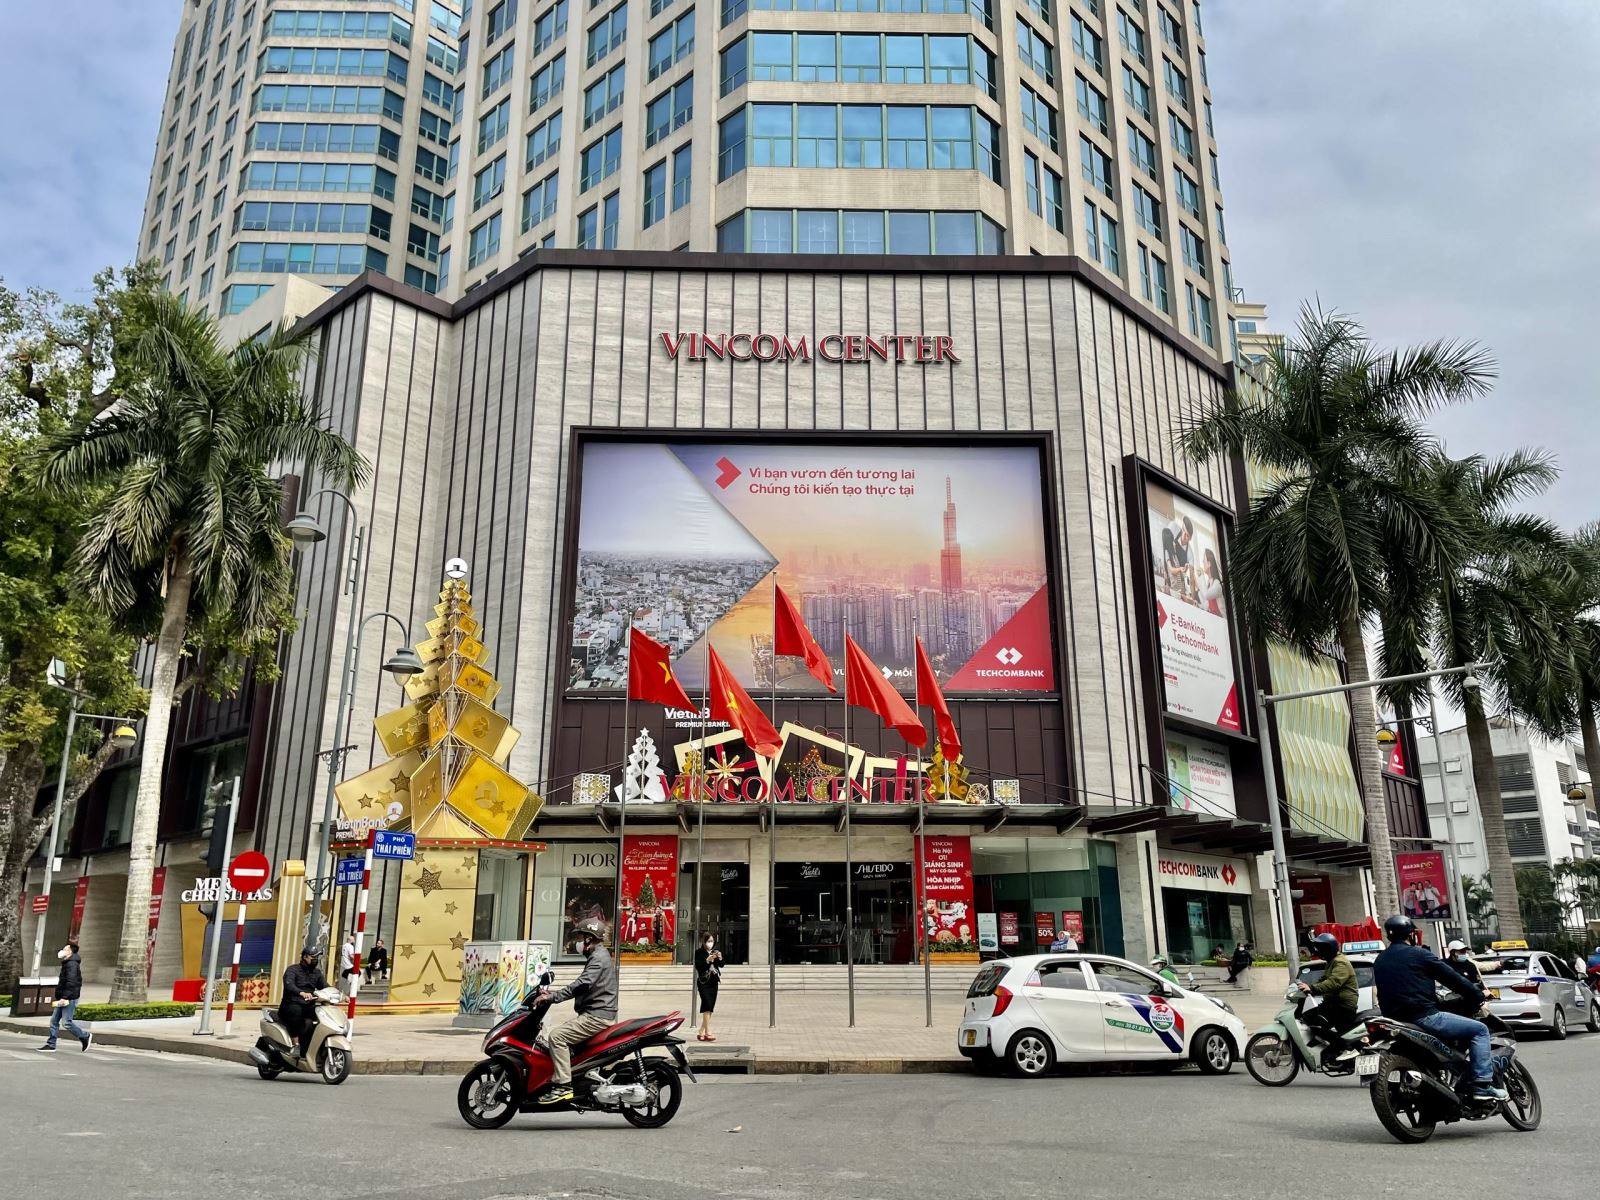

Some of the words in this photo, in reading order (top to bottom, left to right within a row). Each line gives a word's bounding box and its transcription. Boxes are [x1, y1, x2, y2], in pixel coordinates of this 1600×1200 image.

[659, 332, 812, 361] VINCOM
[819, 334, 960, 362] CENTER
[764, 468, 788, 481] bạn
[791, 470, 826, 479] vươn
[830, 467, 853, 479] đến
[857, 469, 898, 482] tương
[901, 469, 915, 480] lai
[750, 483, 790, 496] Chúng
[794, 484, 810, 494] tôi
[814, 482, 838, 494] kiến
[843, 484, 862, 496] tạo
[866, 485, 896, 498] thực
[899, 485, 914, 498] tại
[1170, 613, 1206, 639] E-Banking
[1172, 629, 1220, 656] Techcombank
[657, 774, 800, 802] VINCOM
[806, 776, 941, 803] CENTER
[336, 816, 387, 830] VietinBank
[376, 842, 392, 854] THÁI
[392, 844, 412, 856] PHIÊN
[572, 853, 616, 868] DIOR
[854, 864, 894, 874] SHISEIDO
[1158, 860, 1220, 880] TECHCOMBANK
[944, 876, 961, 885] NHỊP
